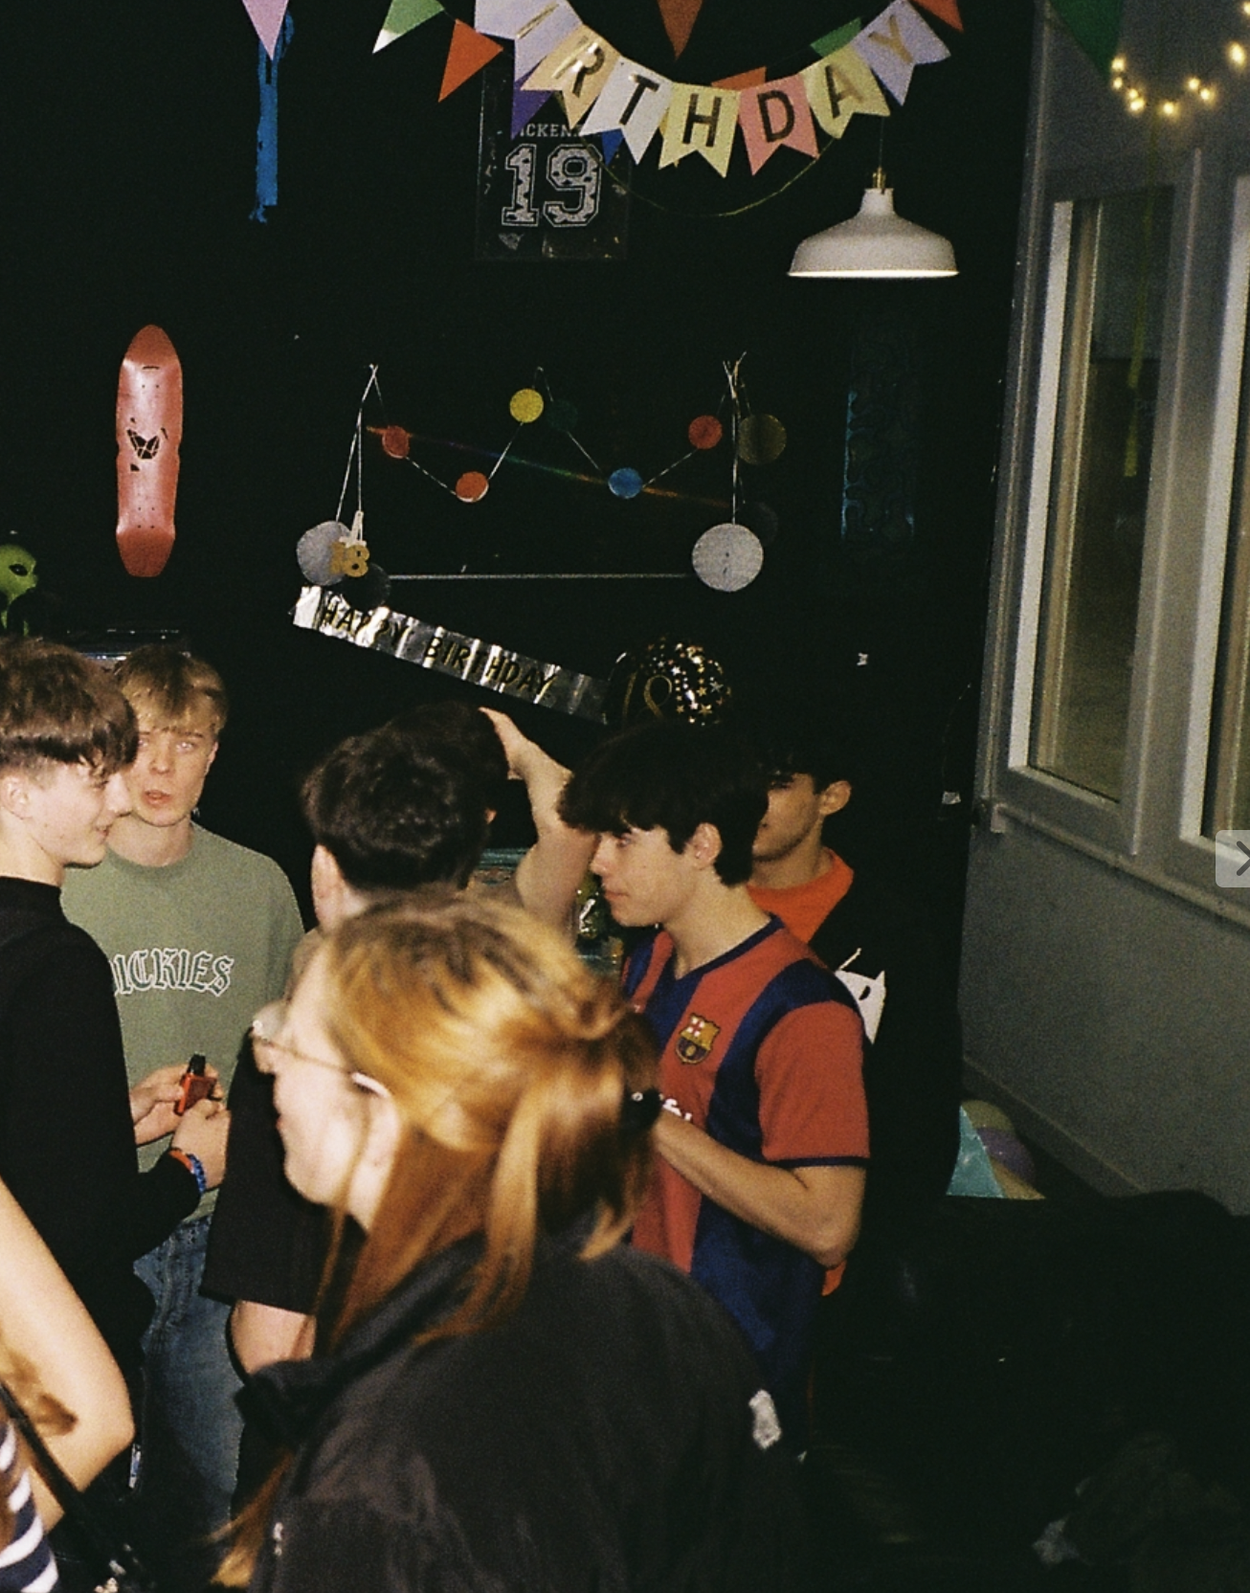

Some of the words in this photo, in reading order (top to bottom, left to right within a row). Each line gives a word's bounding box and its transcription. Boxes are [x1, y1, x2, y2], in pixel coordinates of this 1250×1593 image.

[518, 122, 583, 138] CKEN
[501, 143, 603, 227] 19
[423, 636, 557, 696] BIRTHDAY
[108, 947, 235, 997] ICKIES
